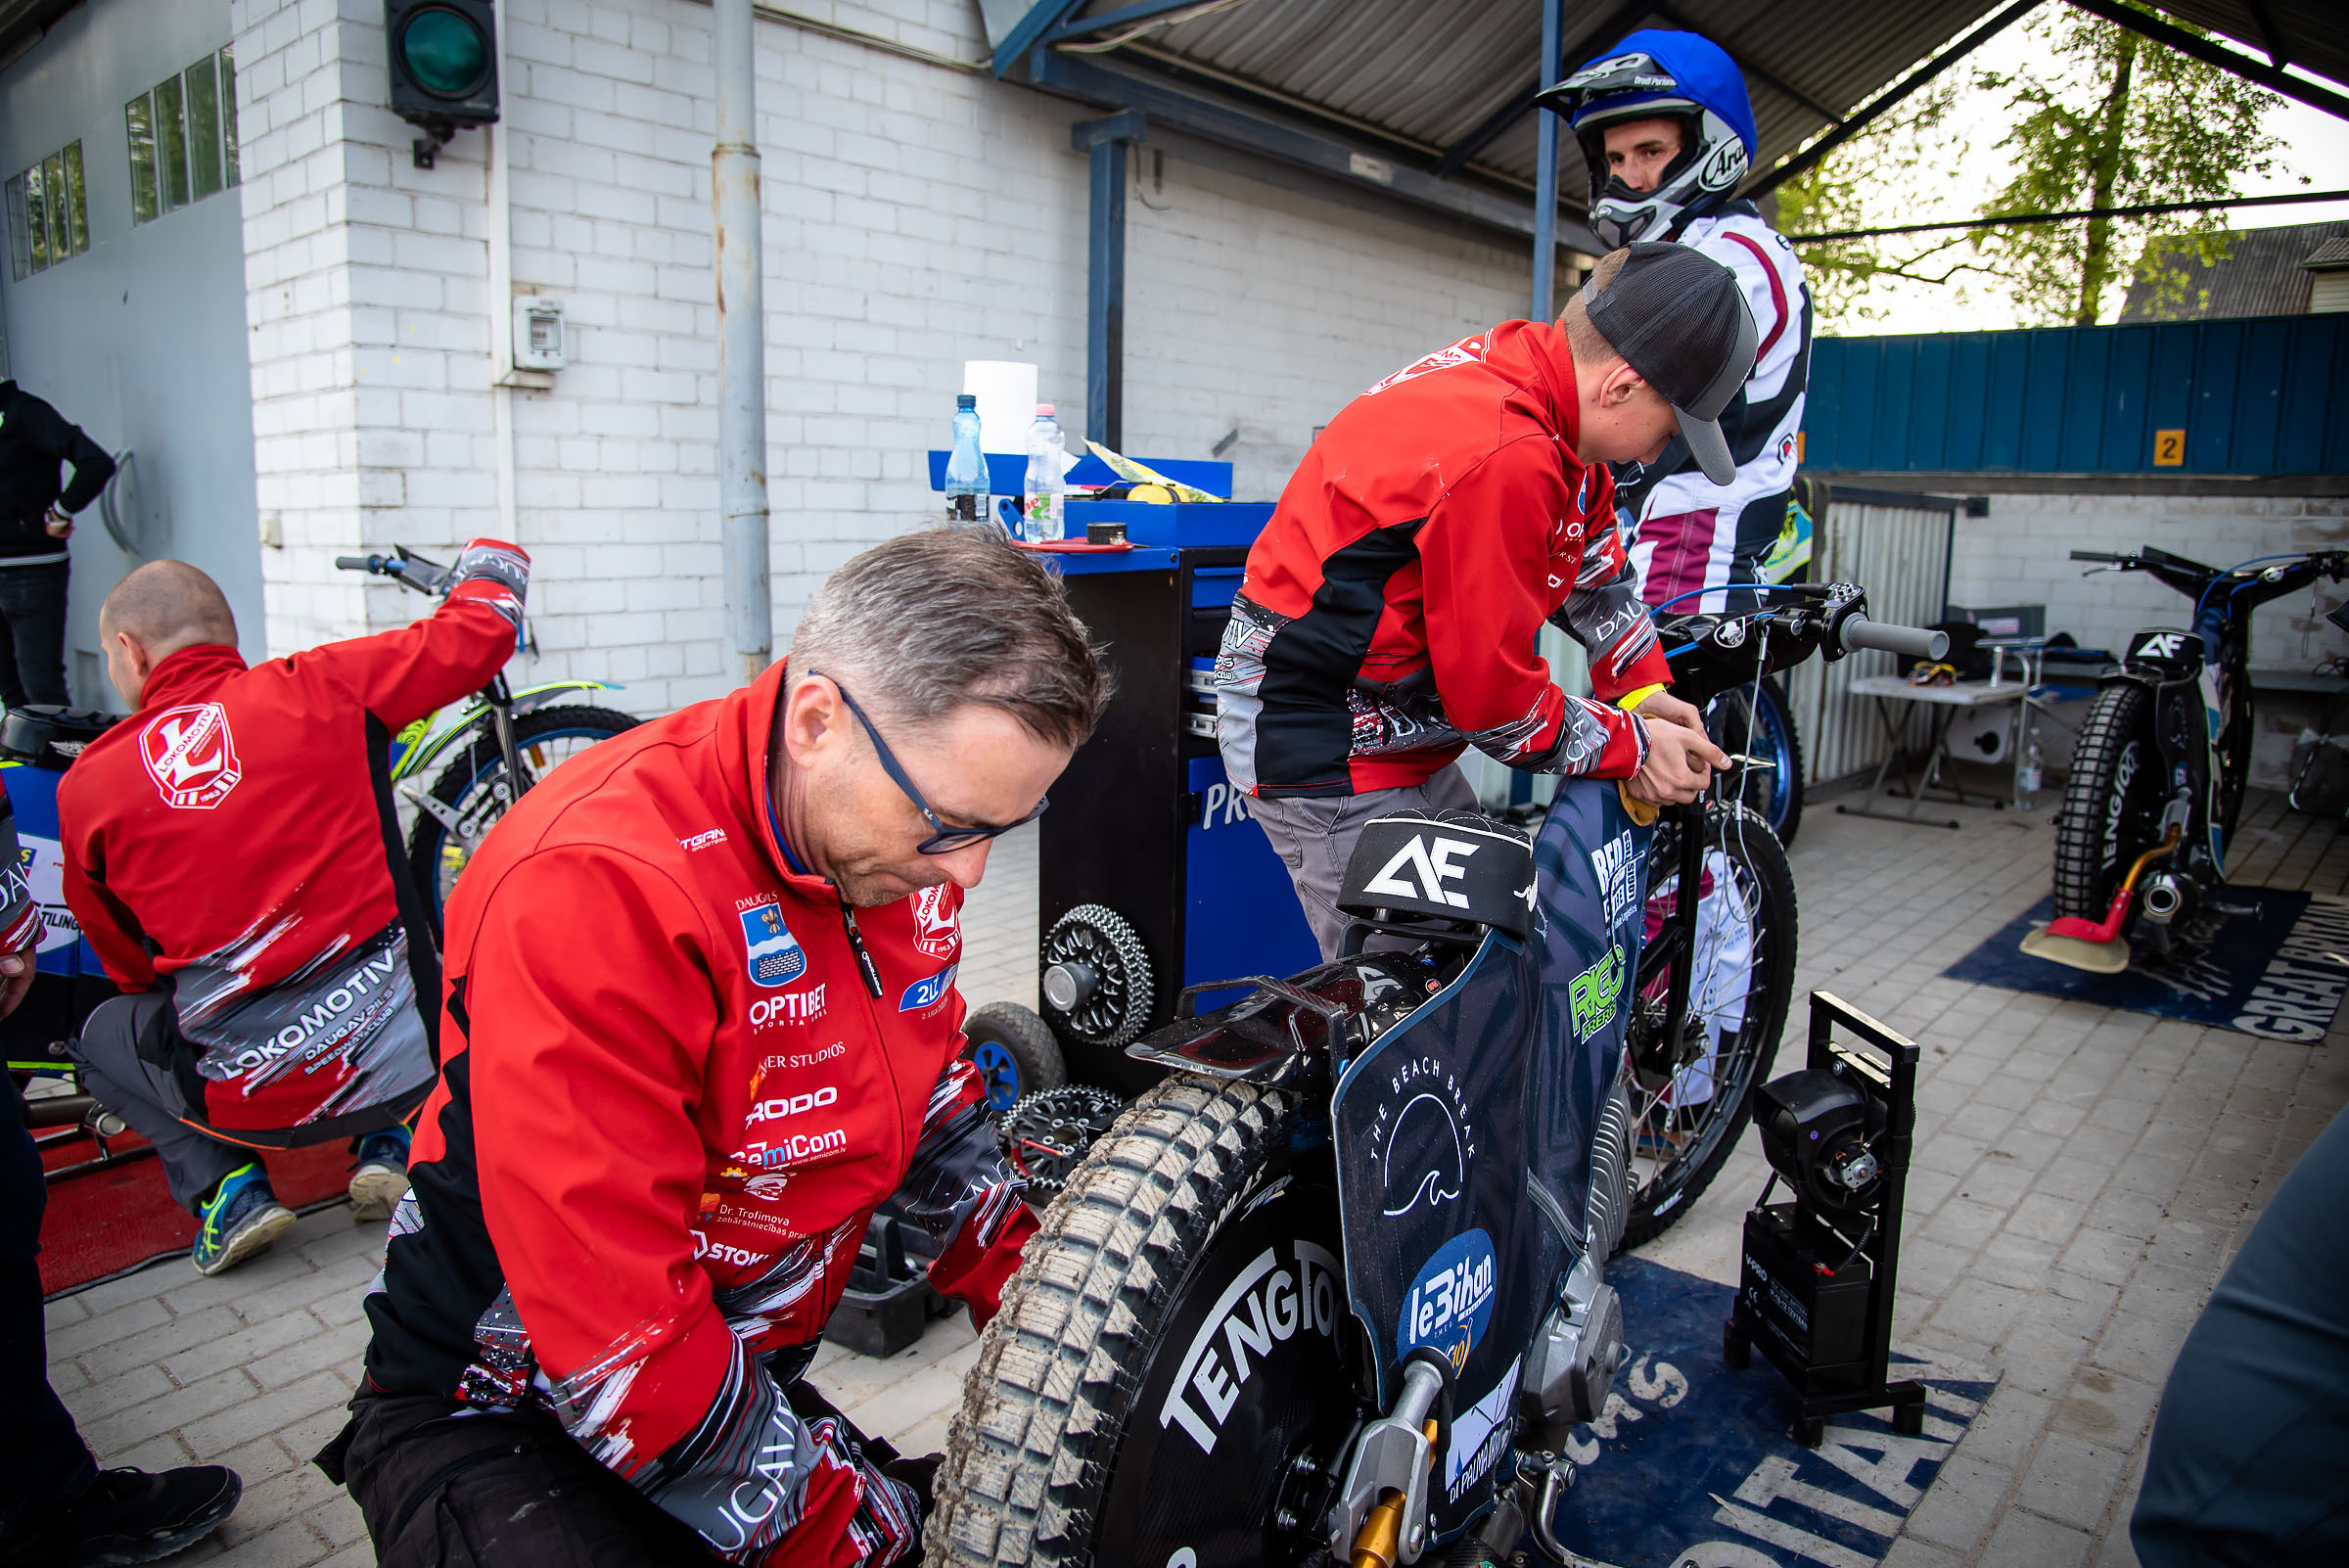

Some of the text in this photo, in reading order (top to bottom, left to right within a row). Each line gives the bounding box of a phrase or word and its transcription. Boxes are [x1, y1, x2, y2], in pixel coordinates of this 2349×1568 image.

[2162, 437, 2178, 459] 2
[159, 709, 212, 773] LOKOMOTIV
[1363, 834, 1481, 909] AE
[216, 947, 395, 1082] LOKOMOTIV
[749, 983, 827, 1026] OPTIBET
[2232, 957, 2349, 1042] GREAT
[303, 988, 395, 1062] DAUGAVPILS
[753, 1020, 806, 1036] SPORTA
[790, 1040, 846, 1068] STUDIOS
[1370, 1056, 1476, 1160] THE BEACH BREAK
[791, 1146, 848, 1167] www.semicom.lv
[716, 1216, 787, 1236] zobārstniecības
[719, 1204, 791, 1227] Dr. Trofimova
